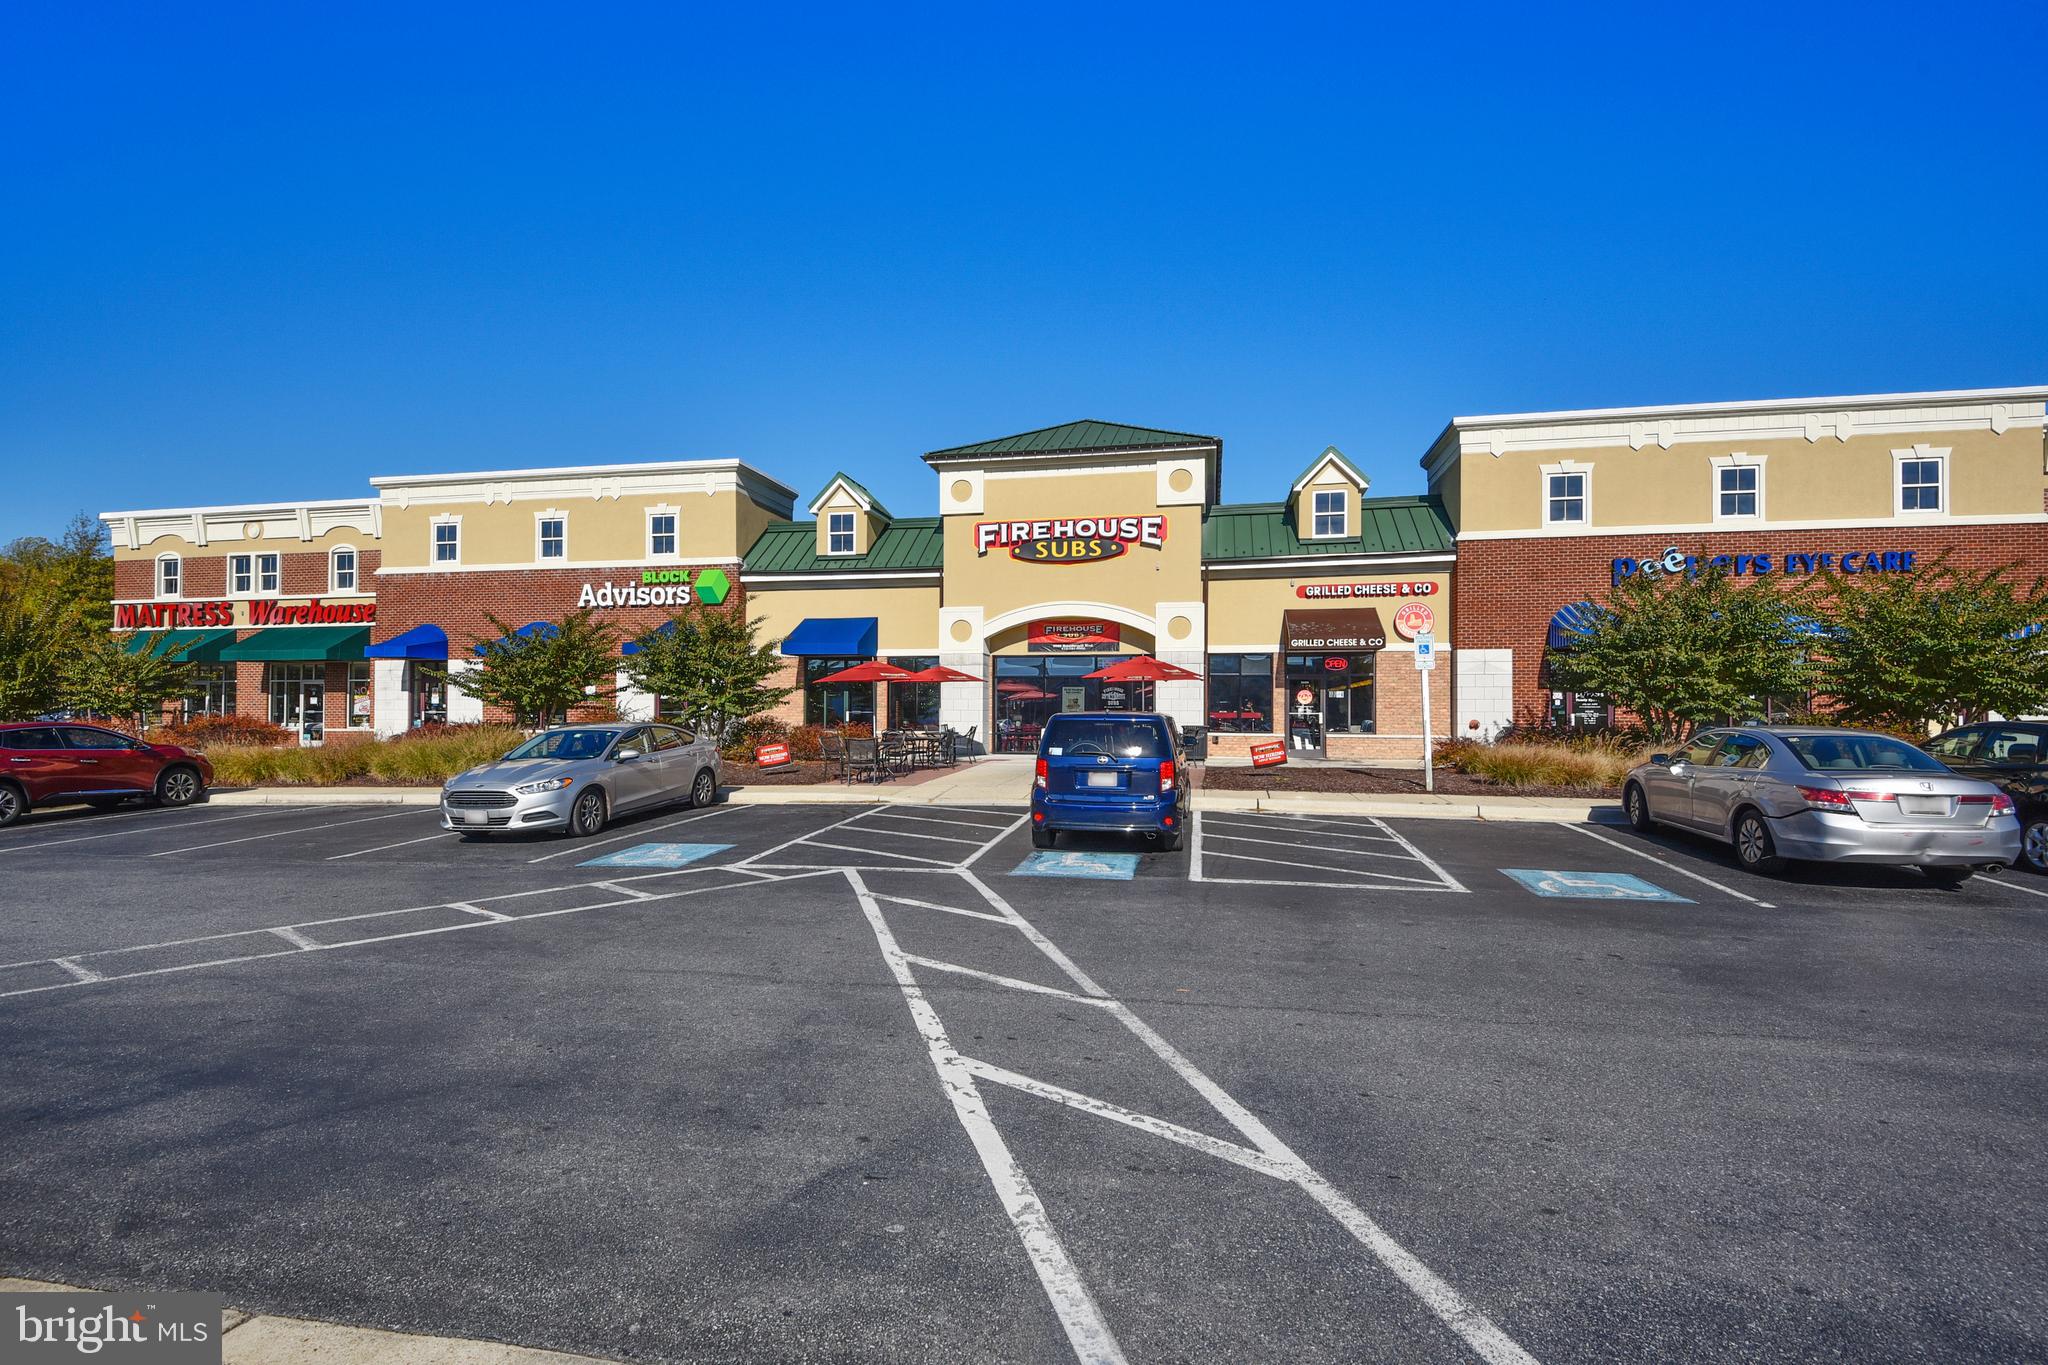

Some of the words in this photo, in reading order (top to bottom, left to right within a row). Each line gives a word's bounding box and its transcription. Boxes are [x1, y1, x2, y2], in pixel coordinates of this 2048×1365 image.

[978, 516, 1163, 555] FIREHOUSE
[1035, 540, 1102, 559] SUBS
[1787, 552, 1836, 574] EYE
[1842, 551, 1918, 573] CARE
[642, 571, 691, 584] BLOCK
[577, 581, 690, 608] Advisors
[1306, 585, 1352, 597] GRILLED
[1355, 583, 1397, 596] CHEESE
[1402, 583, 1410, 594] &
[1414, 583, 1432, 594] CO
[116, 603, 233, 628] MATTRESS
[248, 598, 376, 625] Warehouse
[1045, 625, 1103, 635] FIREHOUSE
[1291, 639, 1325, 647] GRILLED
[1326, 639, 1358, 647] CHEESE
[1360, 638, 1367, 646] &
[1368, 638, 1383, 646] CO
[1327, 659, 1347, 669] OPEN
